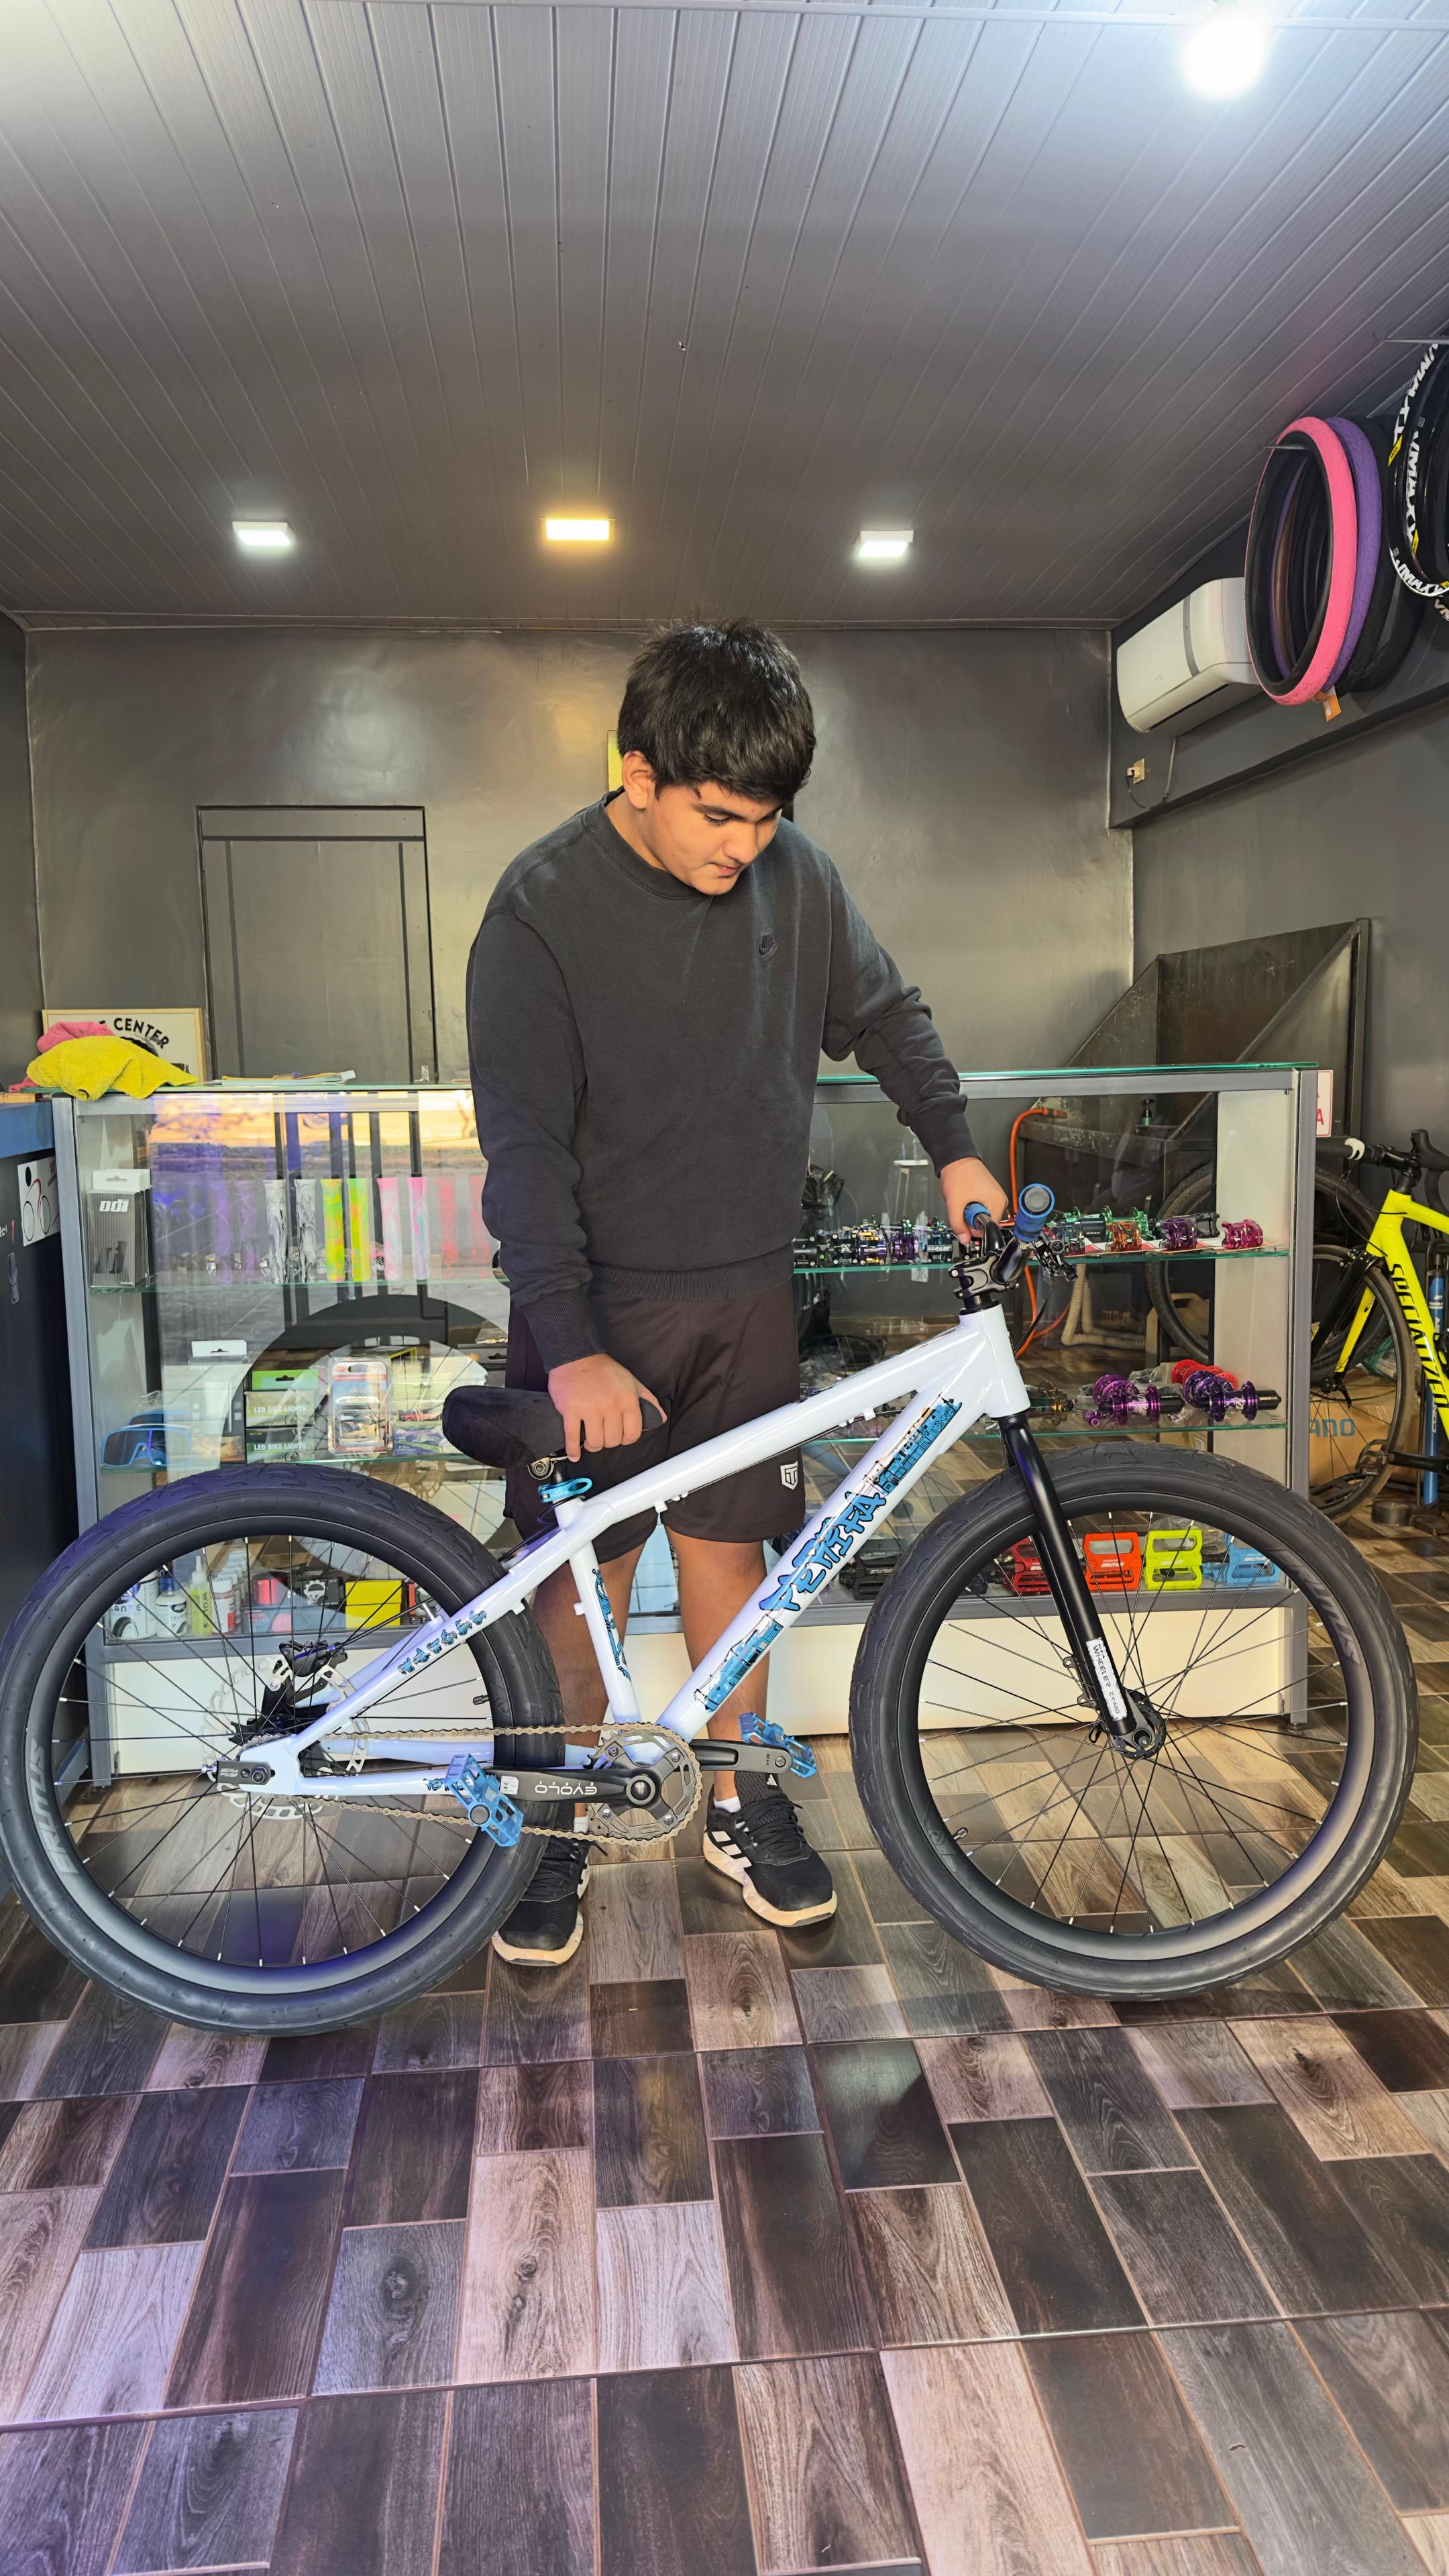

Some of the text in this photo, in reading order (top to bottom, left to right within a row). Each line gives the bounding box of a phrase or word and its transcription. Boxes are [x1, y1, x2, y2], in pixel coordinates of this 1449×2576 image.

[114, 1017, 170, 1049] CENTER
[1390, 1264, 1449, 1408] SPECIALIZED
[1309, 1418, 1356, 1437] ANO
[1093, 1645, 1111, 1687] WHEELER
[30, 1739, 79, 1873] BRUTUS
[535, 1782, 598, 1796] EVOLO
